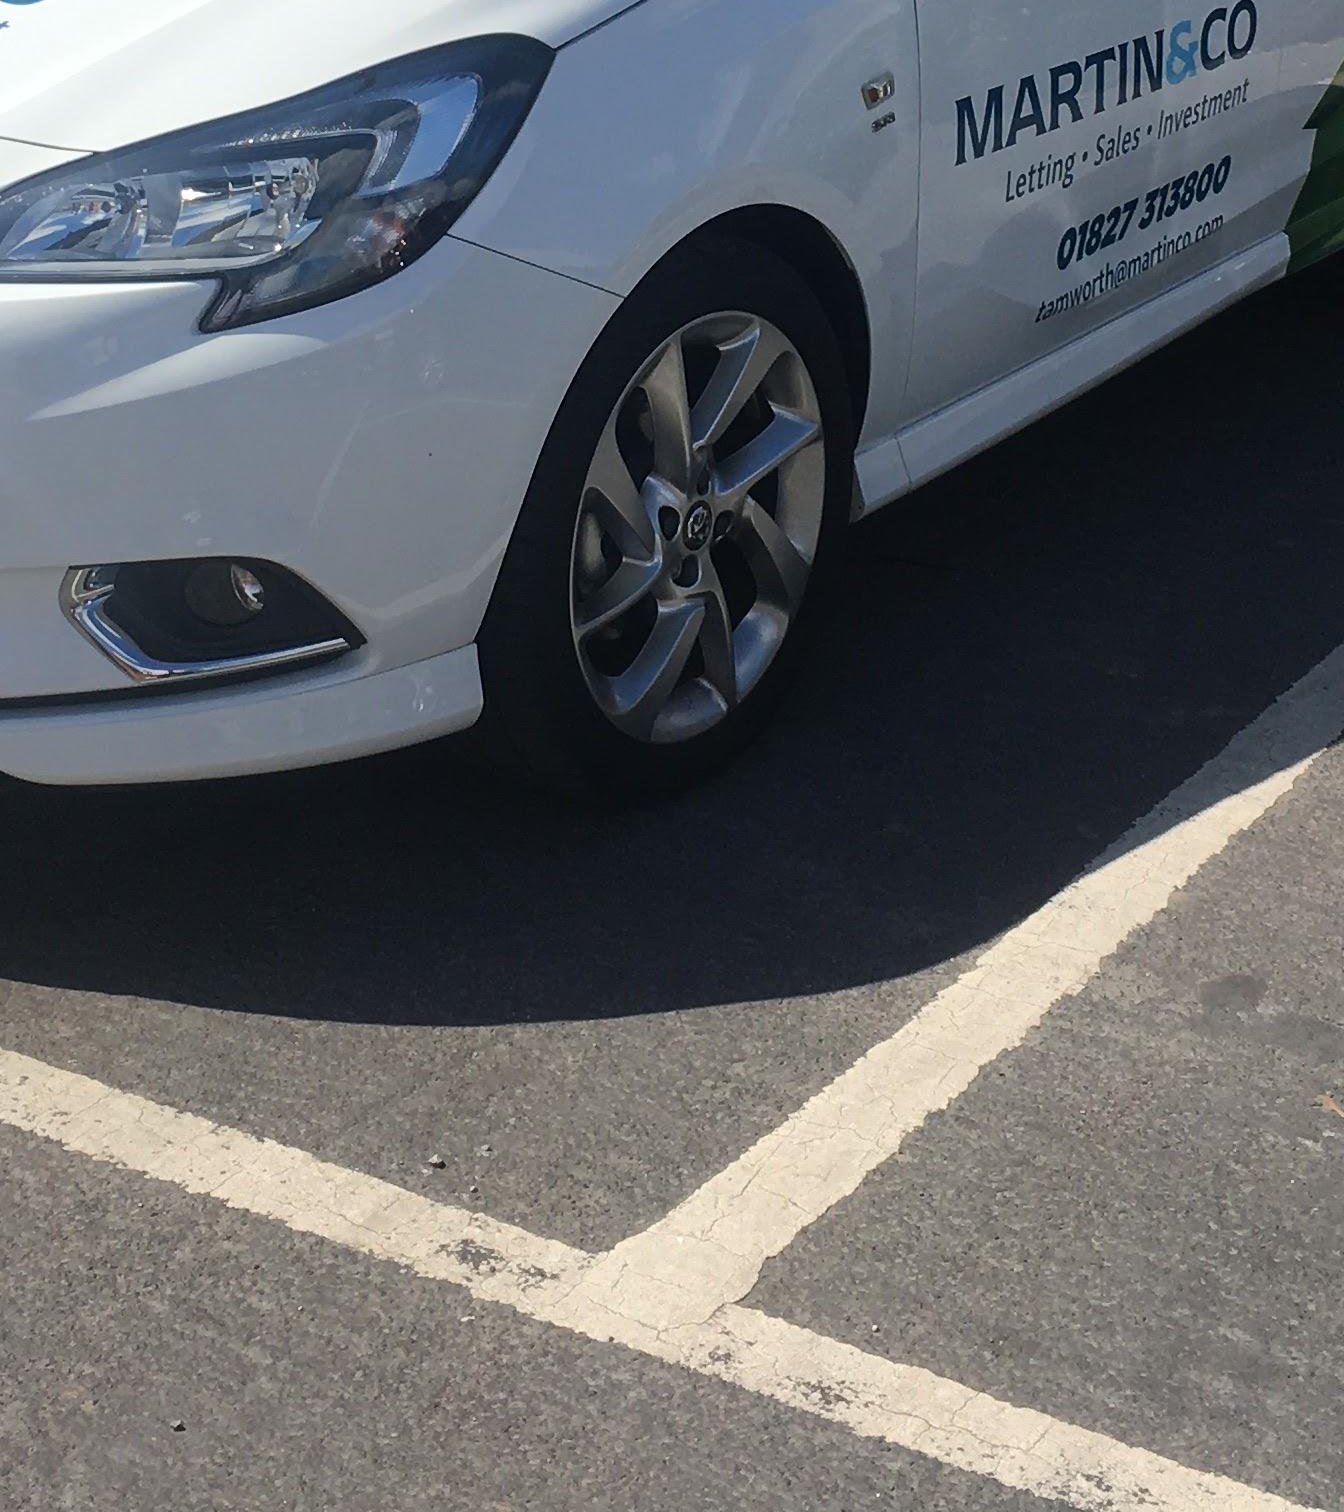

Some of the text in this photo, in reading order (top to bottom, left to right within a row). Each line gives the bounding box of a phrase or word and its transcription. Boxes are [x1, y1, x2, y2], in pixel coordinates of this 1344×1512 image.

[1005, 77, 1251, 203] Letting Sales Investment
[1033, 213, 1225, 324] tamworth@martinco.com
[1057, 155, 1232, 271] 01827 313800
